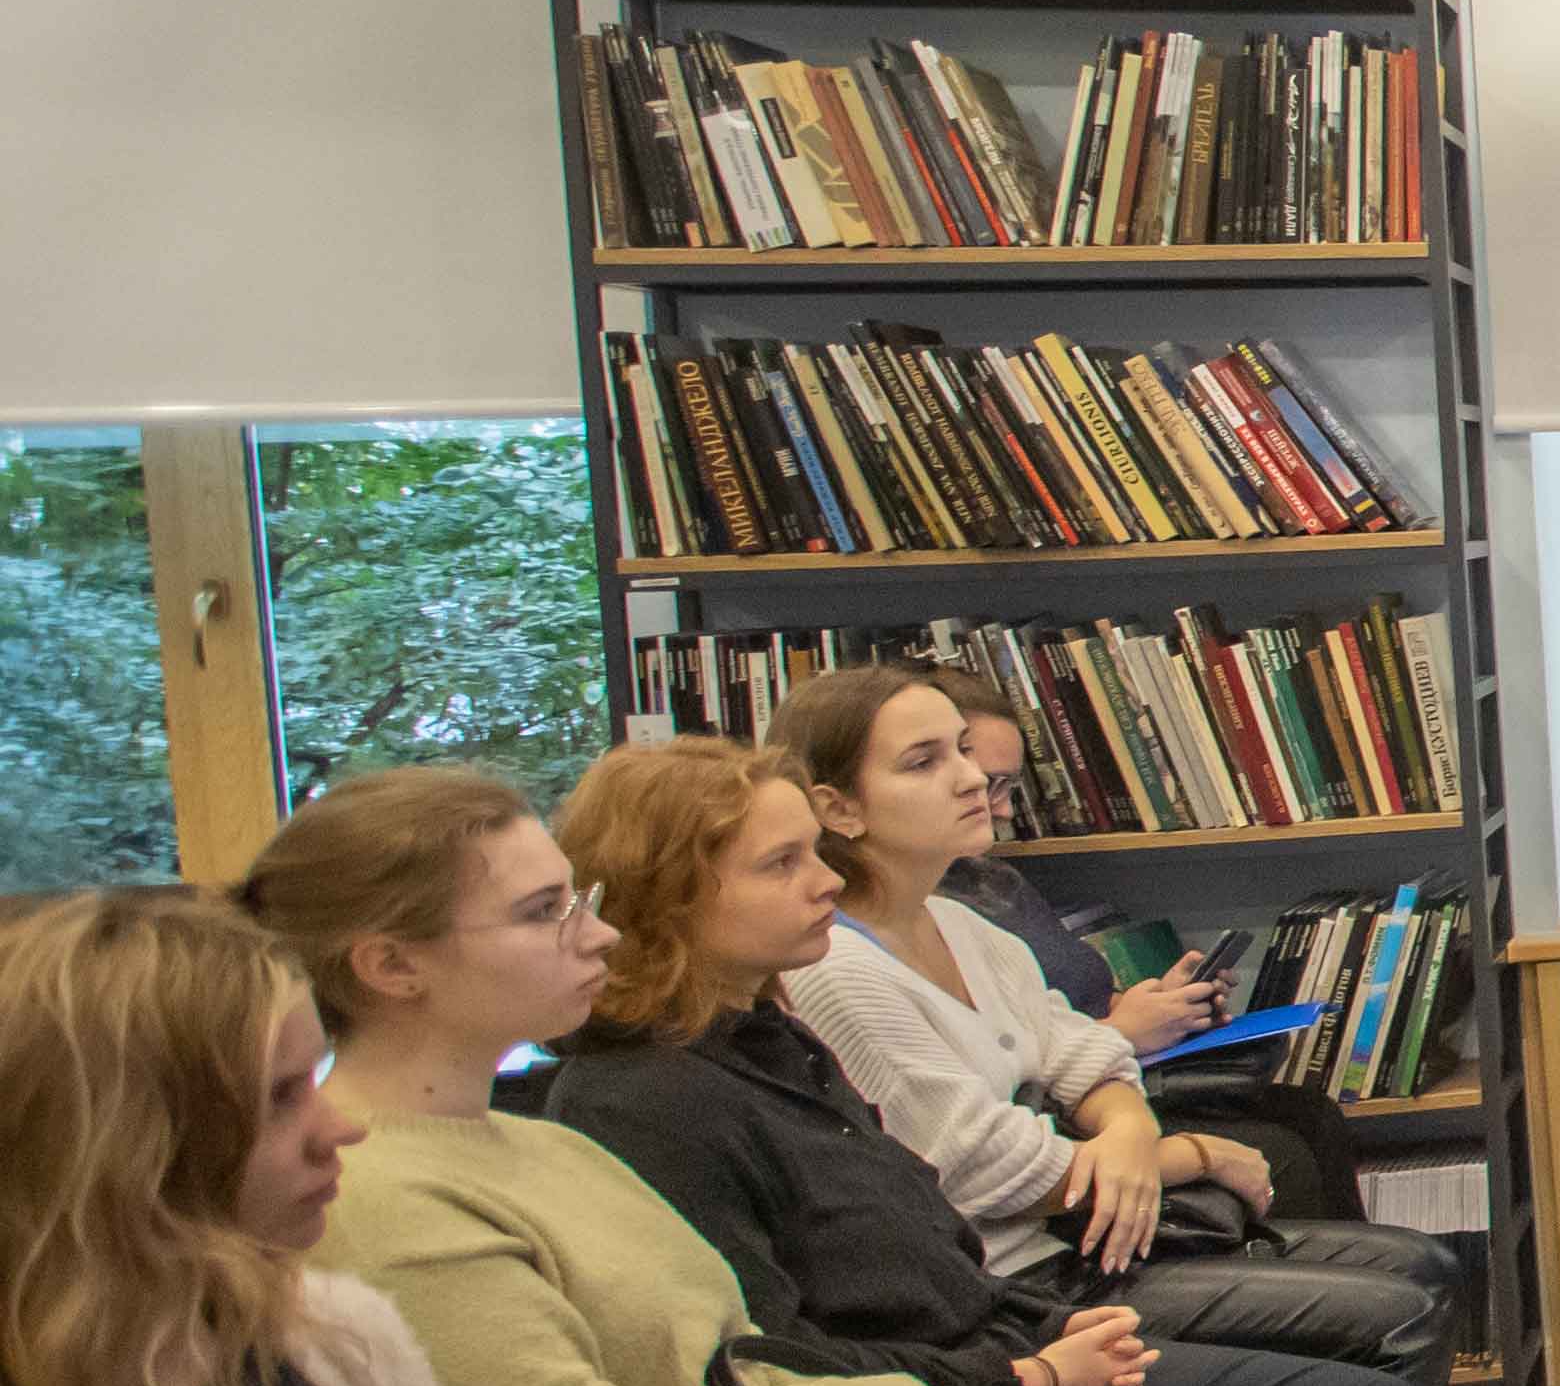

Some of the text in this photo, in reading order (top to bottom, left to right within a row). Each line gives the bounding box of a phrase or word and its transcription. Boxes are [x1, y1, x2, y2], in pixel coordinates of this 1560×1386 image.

[1284, 204, 1296, 236] ДАЛИ
[674, 356, 758, 551] МИКЕЛАНДЖЕЛО
[1197, 402, 1266, 488] ЭКСПРЕССИОНИЗМ
[1414, 659, 1460, 798] Борис КУСТОДИЕВ
[1306, 1026, 1334, 1073] Павел
